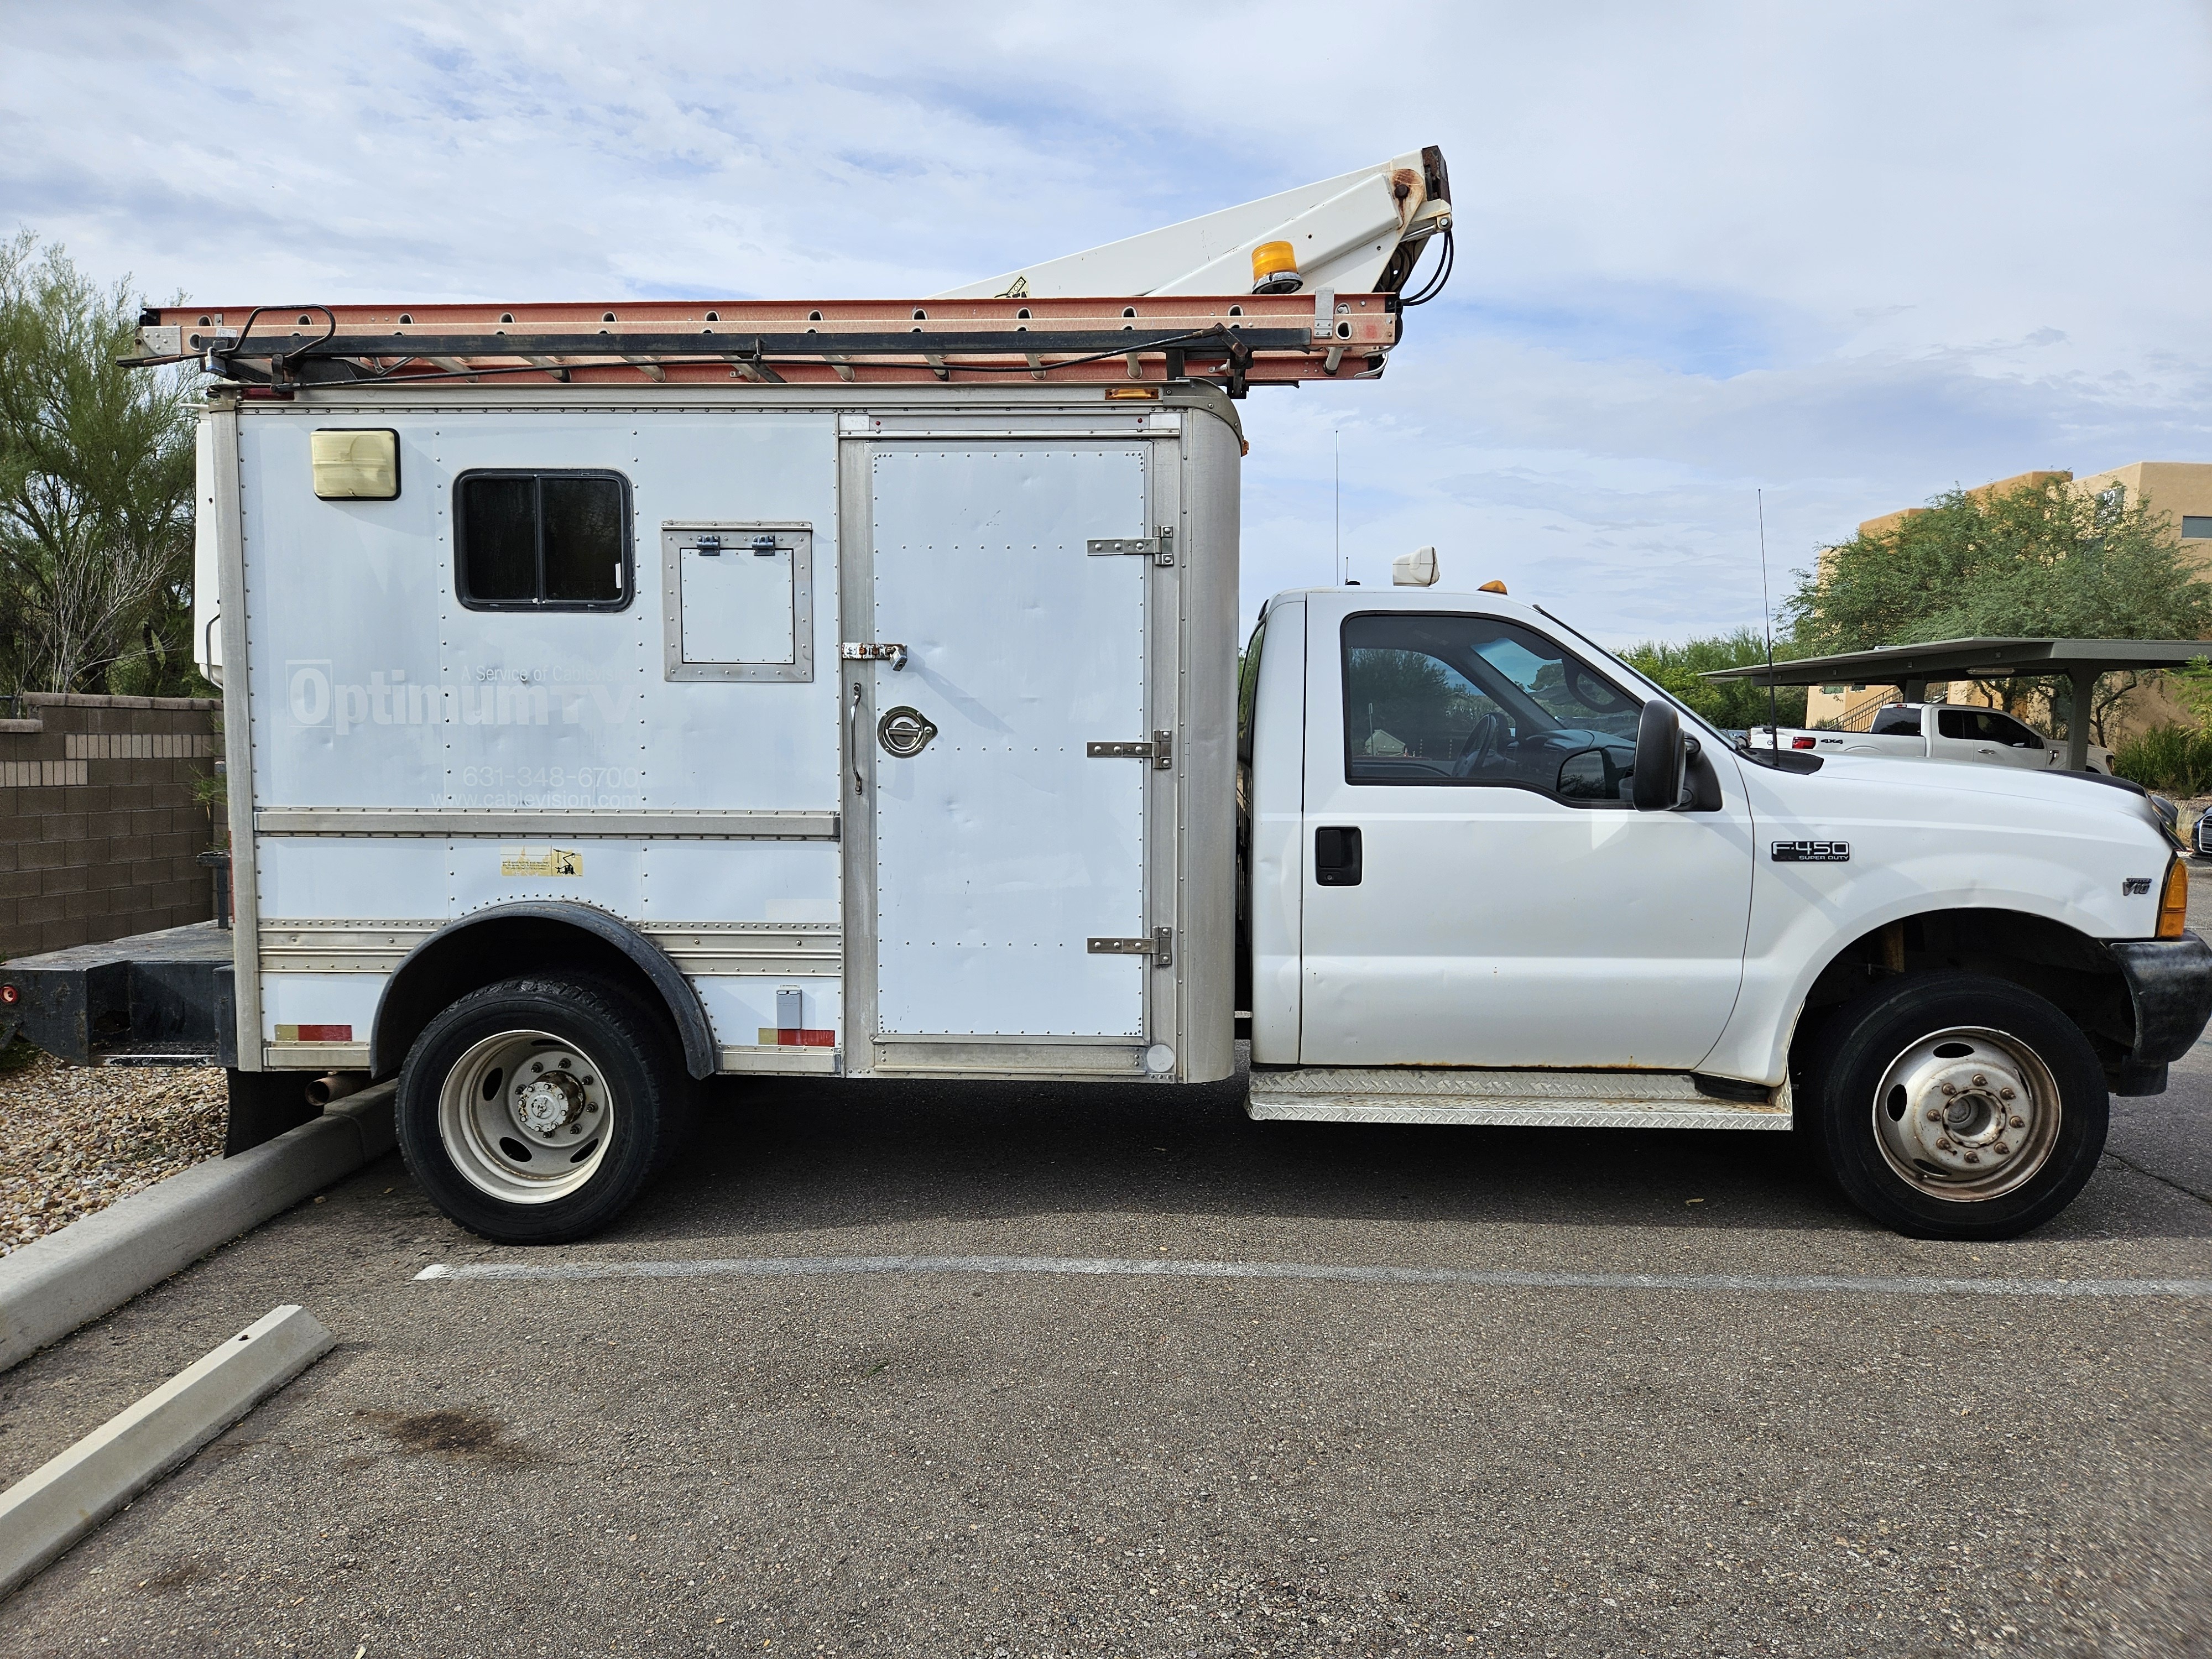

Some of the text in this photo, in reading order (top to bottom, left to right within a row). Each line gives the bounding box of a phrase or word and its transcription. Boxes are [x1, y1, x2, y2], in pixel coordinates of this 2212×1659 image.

[461, 665, 637, 682] A Service of Cablevision
[463, 766, 639, 787] 631-348-6700
[431, 790, 638, 807] www.cablevision.com
[2122, 882, 2150, 896] V10
